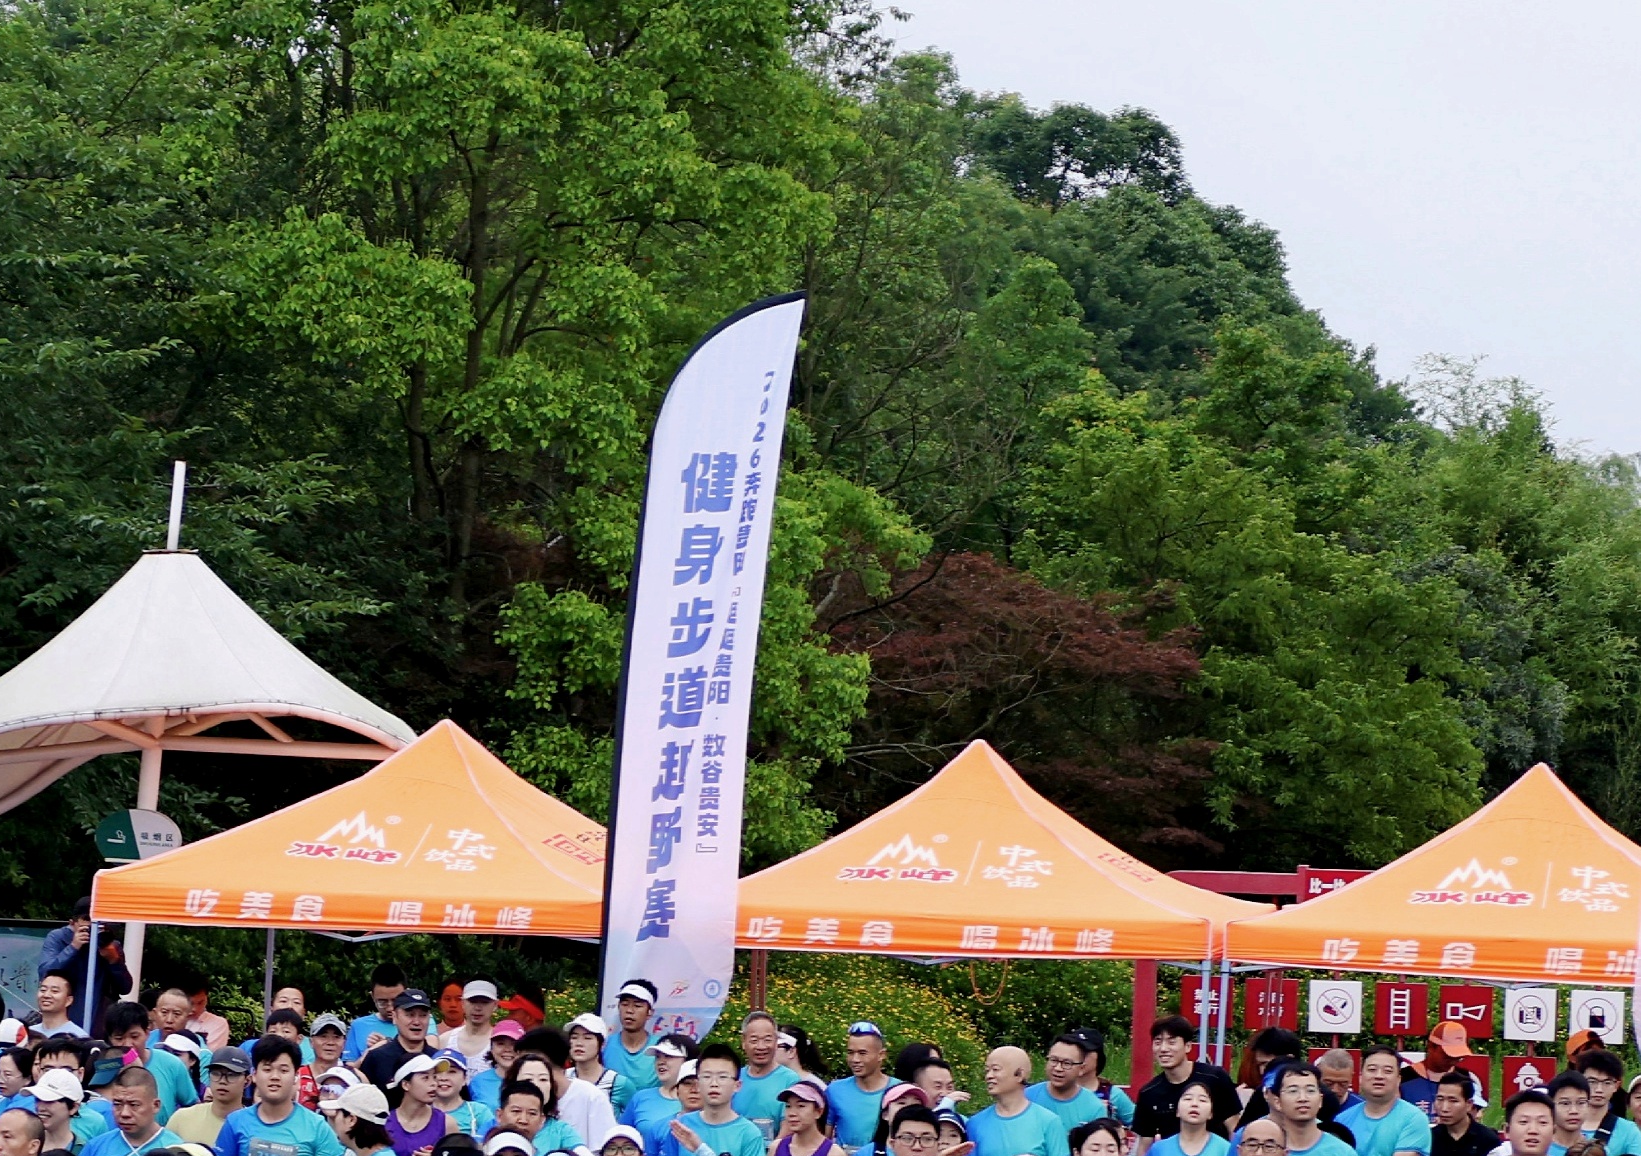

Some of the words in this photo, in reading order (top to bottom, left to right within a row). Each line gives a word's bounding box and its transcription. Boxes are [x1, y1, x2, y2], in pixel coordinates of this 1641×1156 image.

[185, 889, 326, 923] 吃美食
[386, 900, 533, 930] 喝冰峰
[746, 917, 894, 947] 吃美食
[961, 925, 1115, 955] 喝冰峰
[1322, 938, 1476, 969] 吃美食
